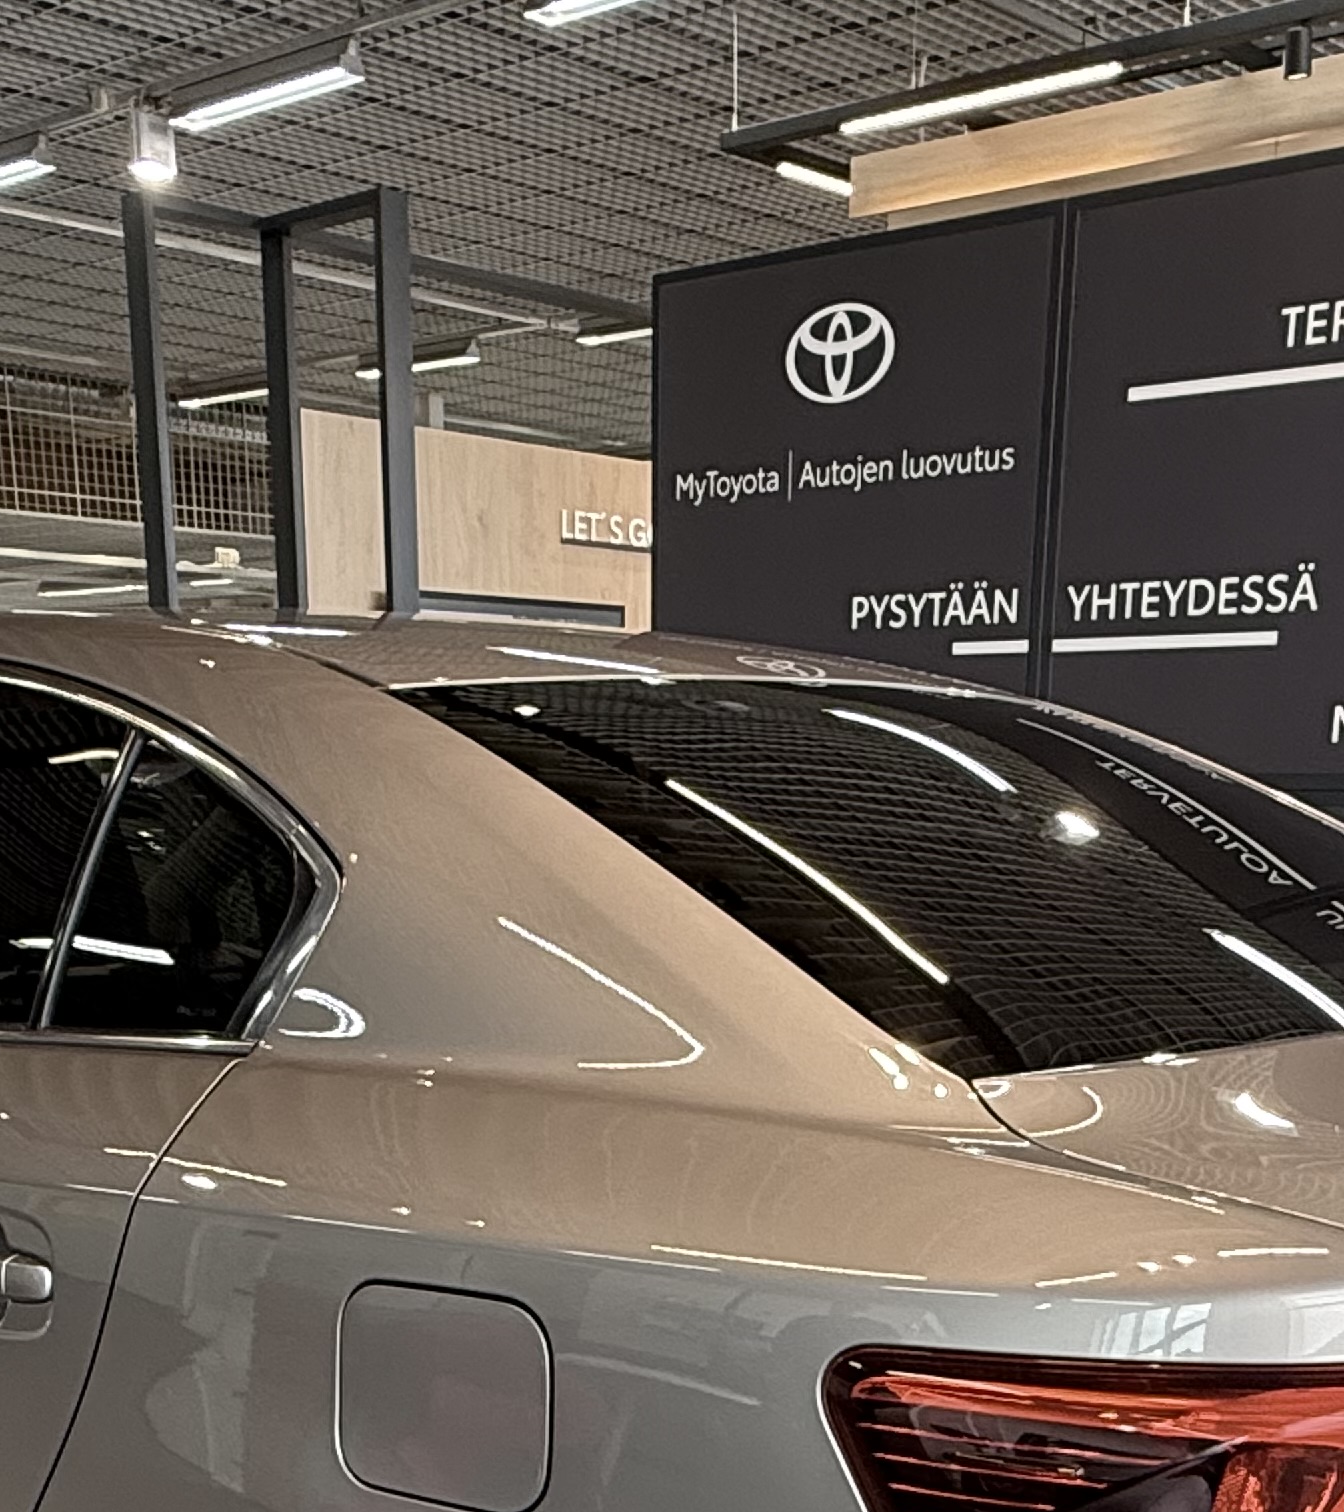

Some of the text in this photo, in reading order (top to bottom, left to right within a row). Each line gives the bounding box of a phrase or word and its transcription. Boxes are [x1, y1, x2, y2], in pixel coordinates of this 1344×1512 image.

[675, 444, 1015, 507] MyToyota Autojen luovutus
[850, 562, 1318, 630] PYSYTÄÄN YHTEYDESSÄ
